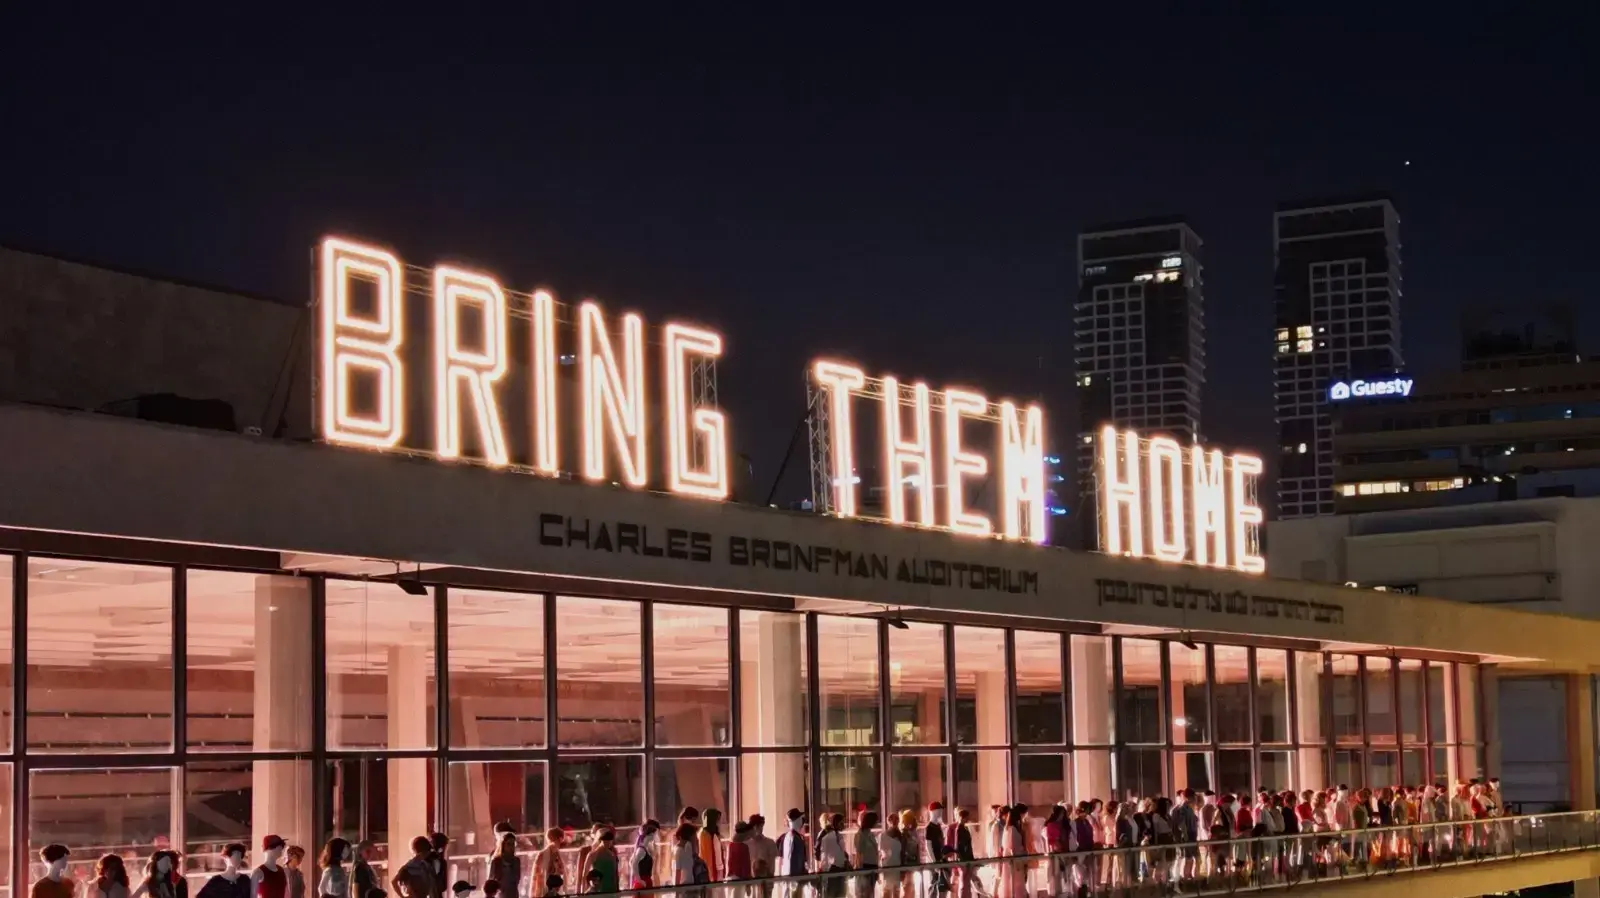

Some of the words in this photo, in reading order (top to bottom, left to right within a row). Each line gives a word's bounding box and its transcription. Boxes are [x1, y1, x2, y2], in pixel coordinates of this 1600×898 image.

[322, 236, 728, 499] BRING
[814, 361, 1047, 543] THEM
[1102, 426, 1266, 573] HOME
[1351, 378, 1413, 397] Guesty
[540, 513, 711, 562] CHARLES
[730, 534, 888, 581] BRONFMAN
[896, 555, 1037, 594] AUDITORIUM
